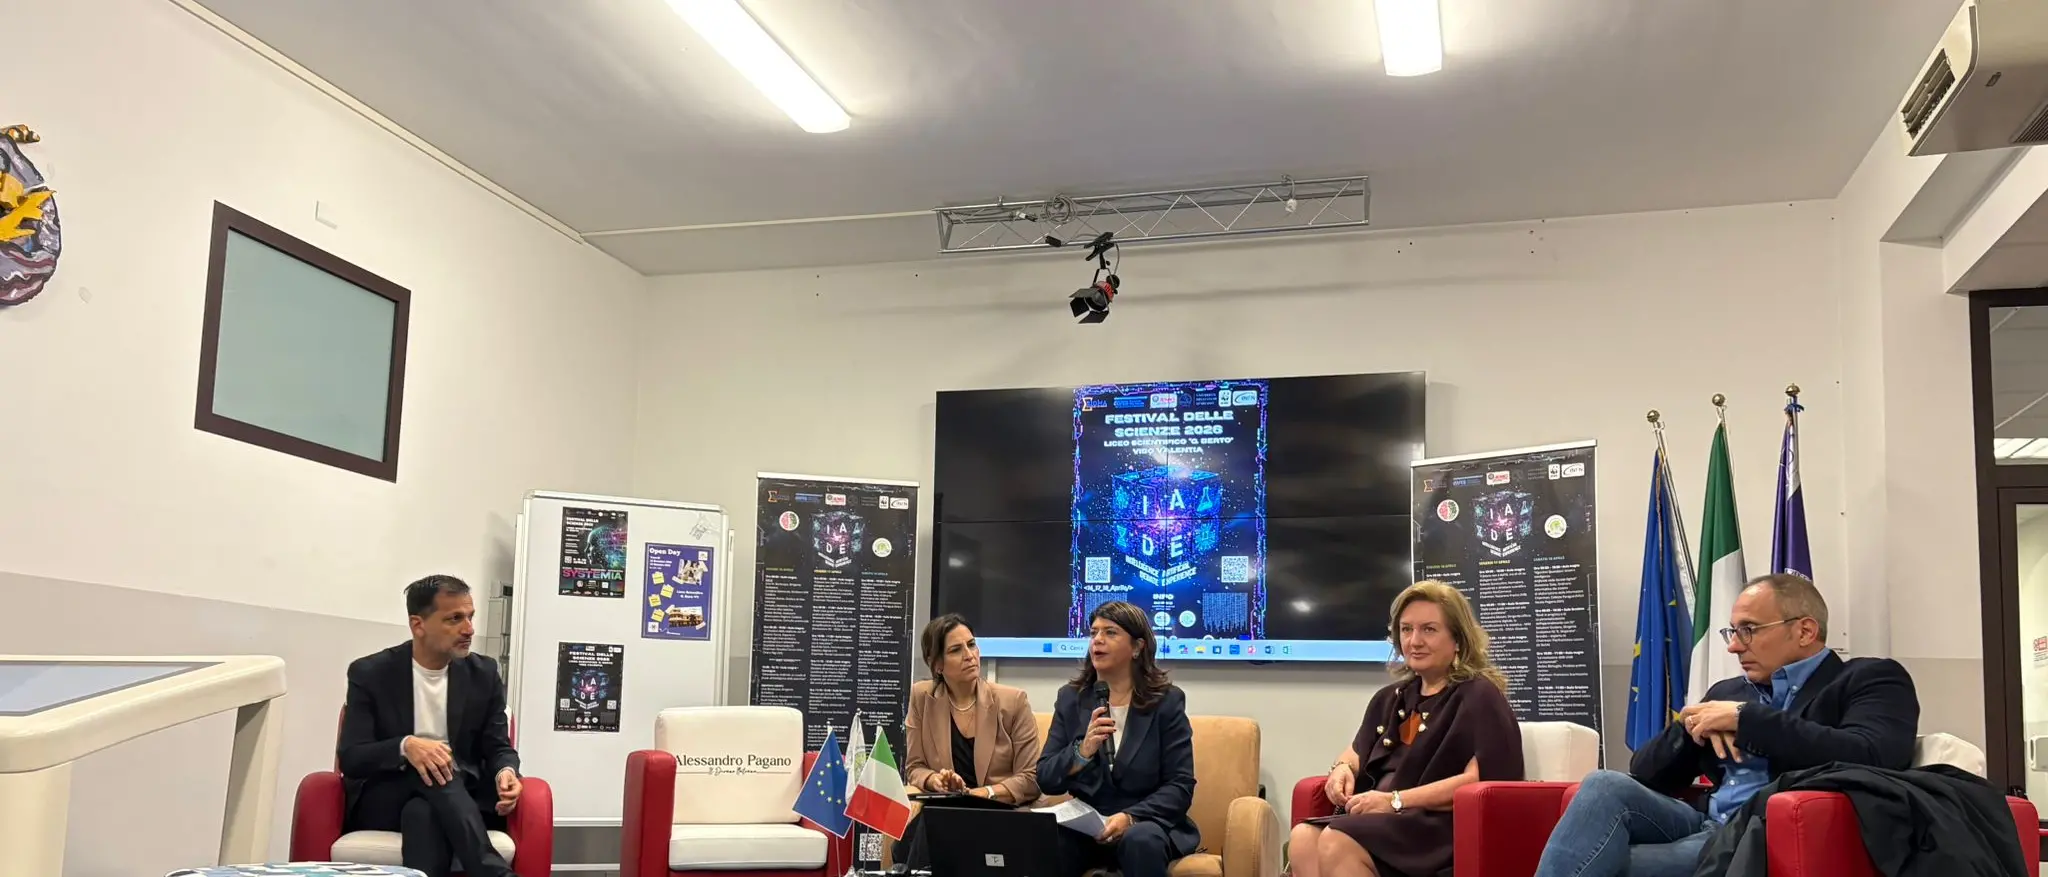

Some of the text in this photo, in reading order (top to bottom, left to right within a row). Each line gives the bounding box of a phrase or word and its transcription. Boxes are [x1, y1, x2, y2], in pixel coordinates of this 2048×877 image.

[1105, 410, 1234, 425] FESTIVAL DELLE
[1114, 425, 1224, 438] SCIENZE 2026
[1131, 438, 1187, 447] SCIENTIFICO
[1155, 446, 1204, 455] VALENTIA
[1142, 489, 1186, 515] I A
[1504, 503, 1513, 515] A
[839, 522, 848, 533] A
[1505, 529, 1514, 541] E
[649, 547, 681, 556] Open Day
[839, 543, 847, 555] E
[1142, 534, 1184, 558] D E
[562, 569, 623, 580] SYSTEMIA
[675, 754, 791, 769] Alessandro Pagano
